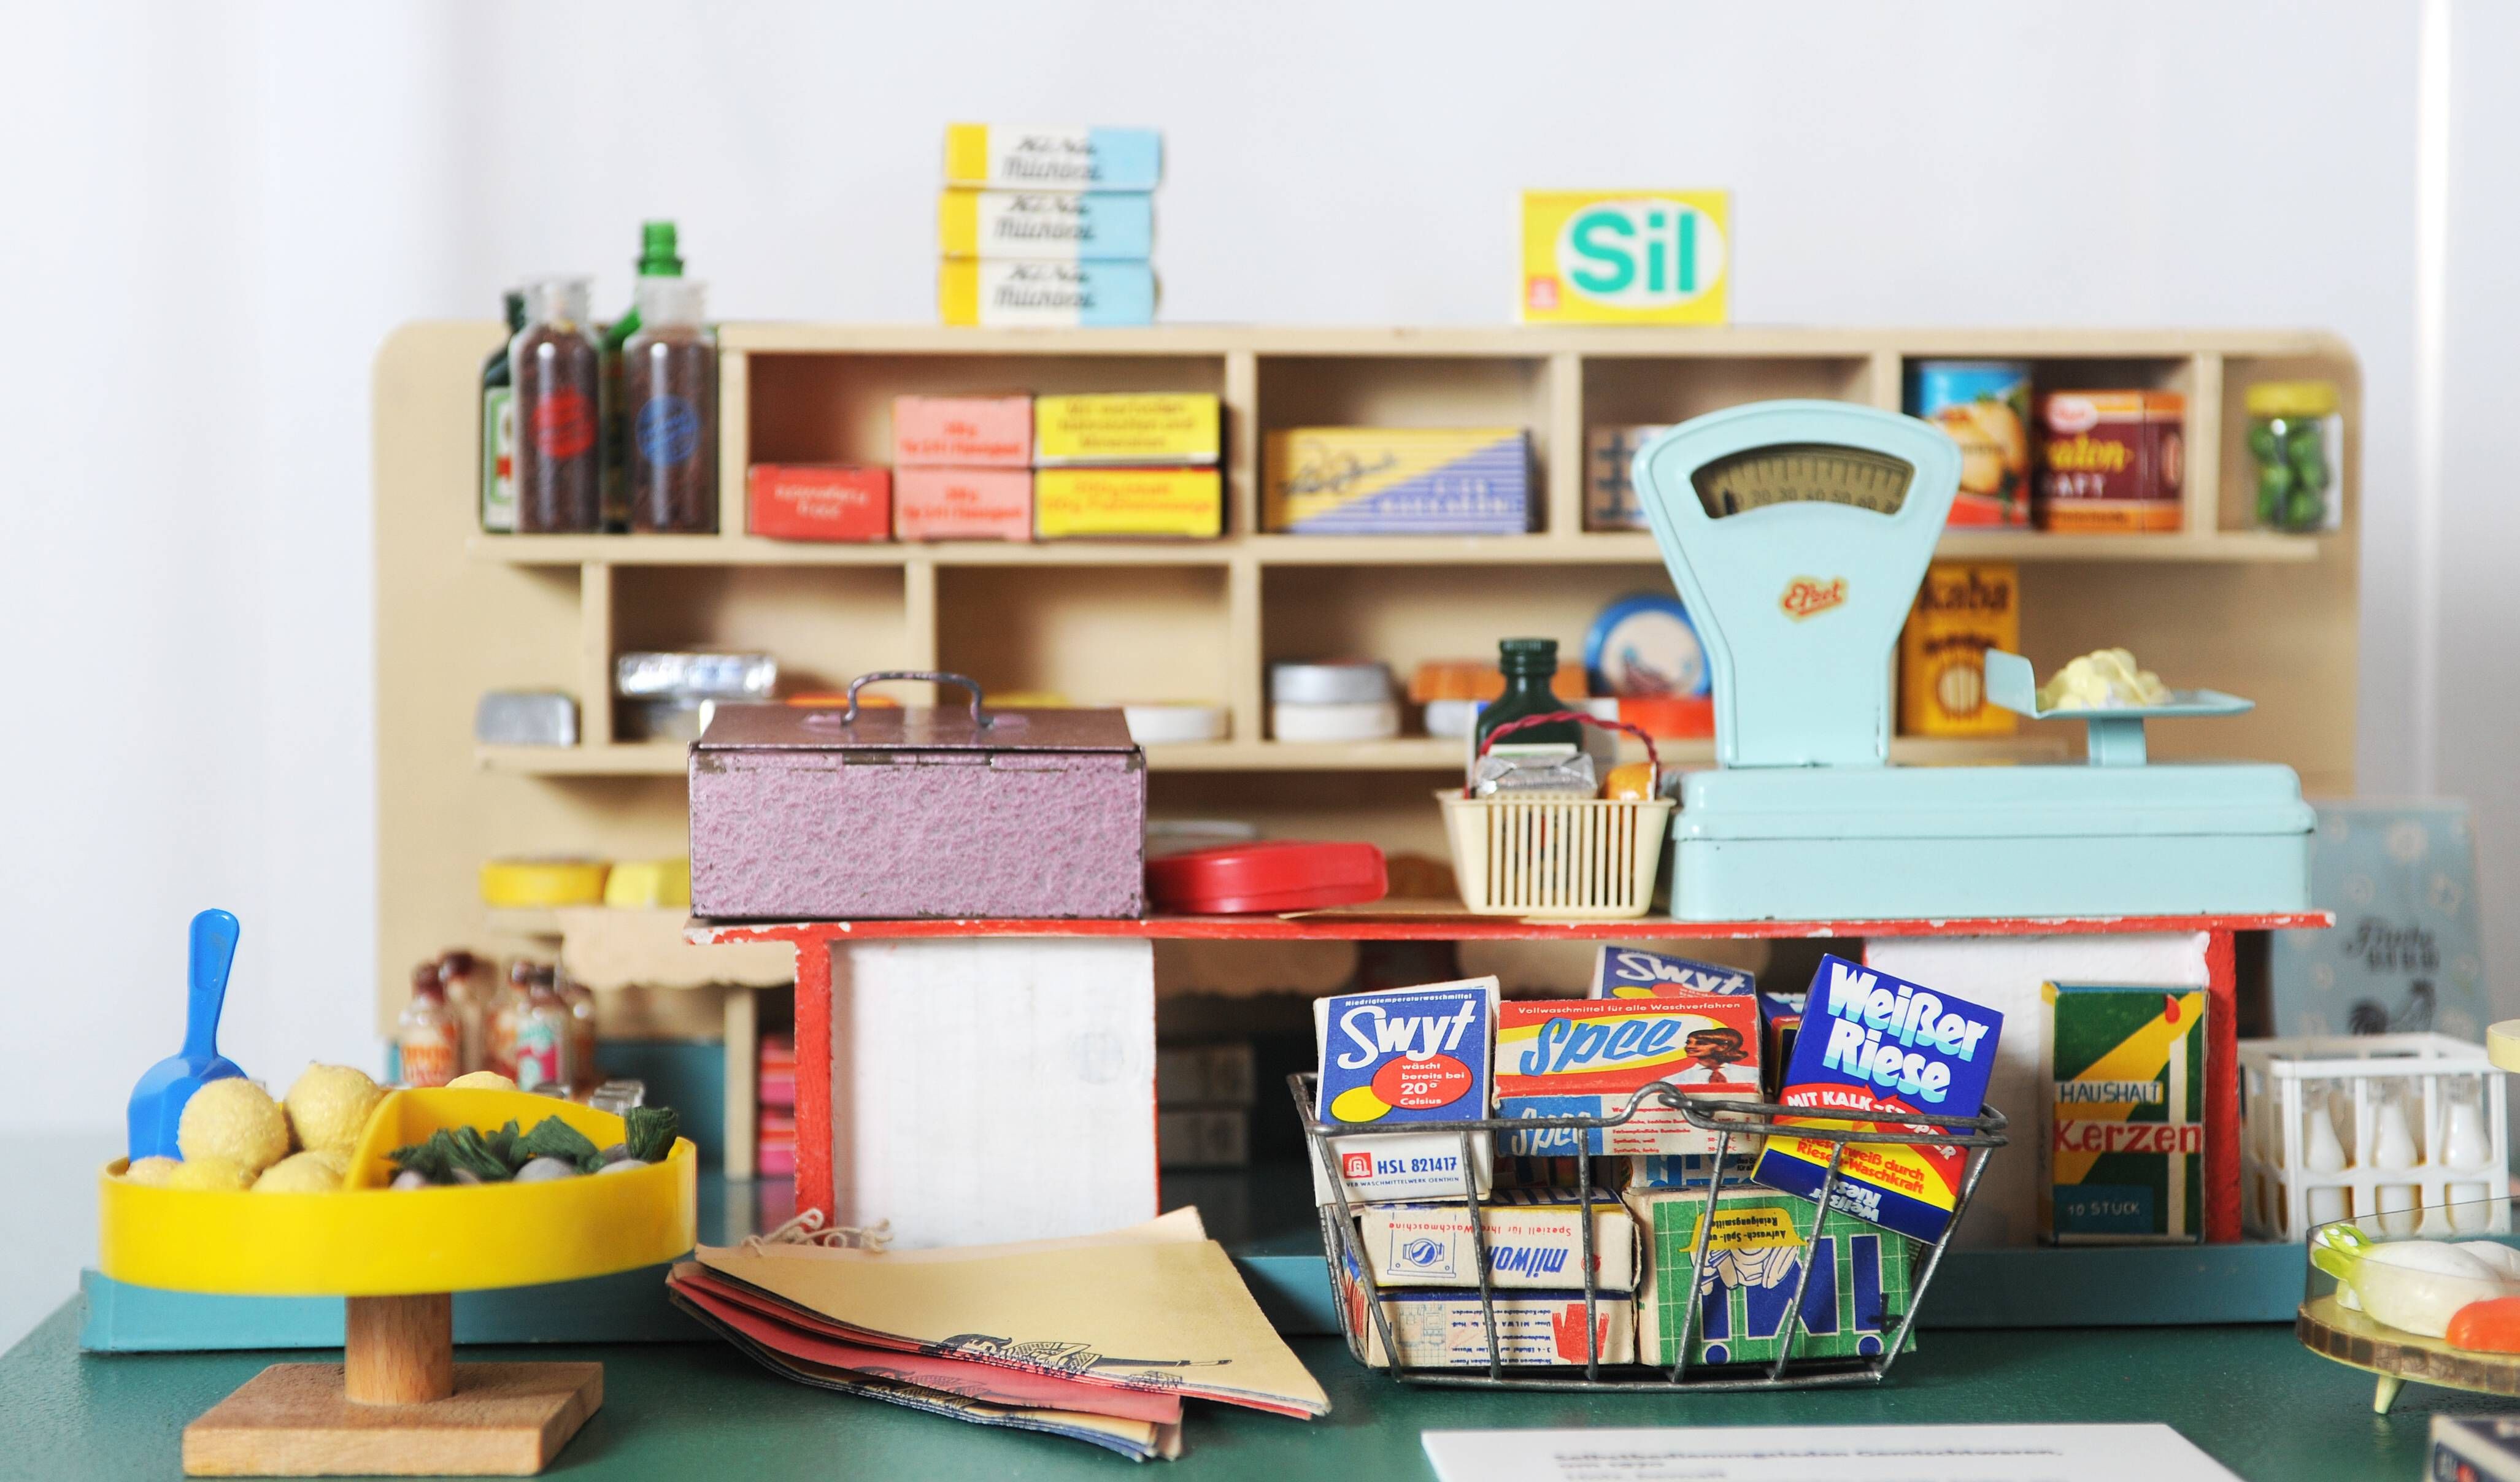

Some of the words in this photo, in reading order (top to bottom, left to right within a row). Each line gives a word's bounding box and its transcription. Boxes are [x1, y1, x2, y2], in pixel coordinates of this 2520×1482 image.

[1572, 210, 1695, 293] Sil
[1616, 952, 1746, 995] Swyt
[1519, 1004, 1604, 1015] Vollwaschmittel
[1625, 1004, 1647, 1012] alle
[1651, 1001, 1741, 1011] Waschverfahren
[1827, 962, 1989, 1062] Weißer
[1338, 1000, 1476, 1069] Swyt
[1520, 1017, 1682, 1077] Spee
[1401, 1062, 1441, 1071] wäscht
[1822, 1018, 1951, 1103] Riese
[1401, 1071, 1442, 1080] bereits
[1445, 1071, 1465, 1080] bei
[1400, 1096, 1442, 1106] Celsius
[1787, 1092, 1817, 1107] MIT
[2060, 1083, 2160, 1104] HAUSHALT
[2054, 1119, 2202, 1154] Kerzen
[1378, 1160, 1406, 1174] HSL
[1411, 1157, 1457, 1172] 821417
[1885, 1159, 1925, 1182] durch
[1809, 1188, 1879, 1223] Weißr
[1389, 1223, 1473, 1234] Waschmaschine
[1507, 1226, 1522, 1235] für
[1528, 1226, 1571, 1237] Speziell
[1711, 1216, 1778, 1229] Reinigungsmitte
